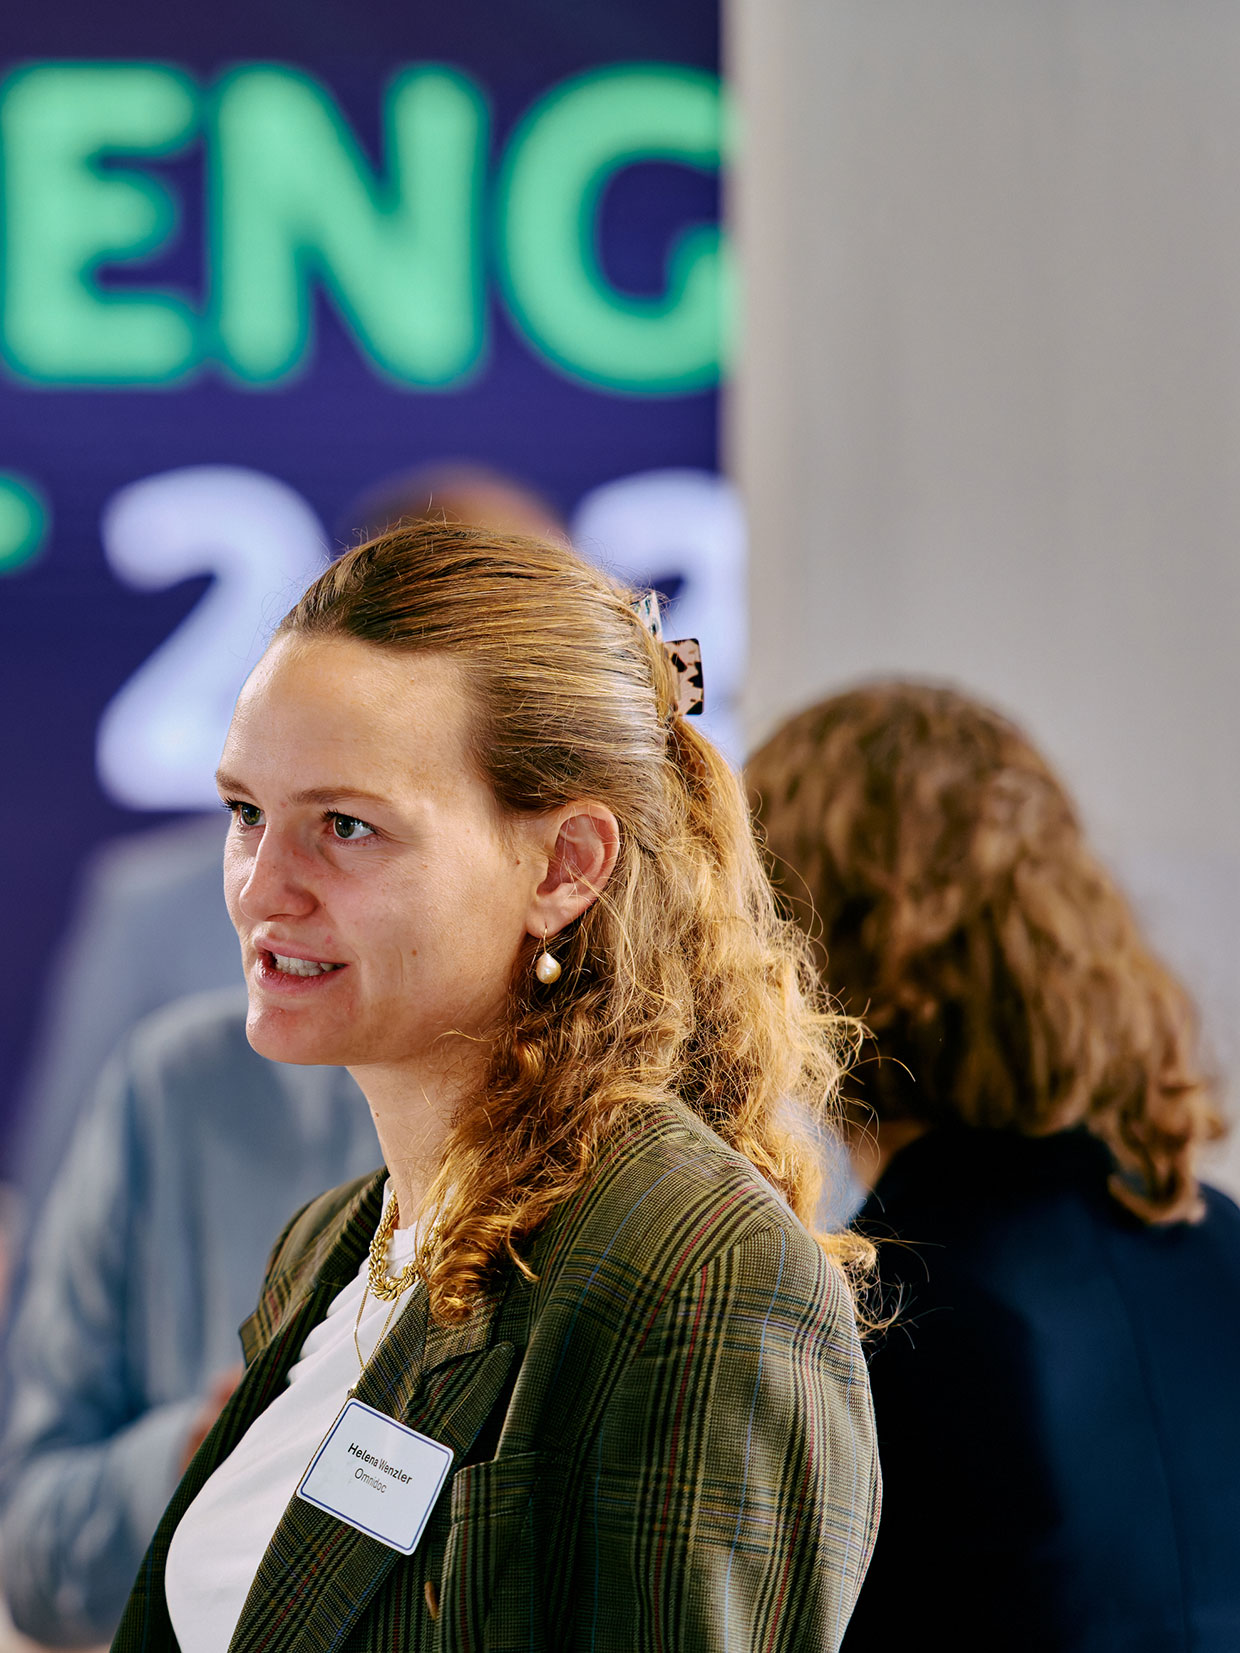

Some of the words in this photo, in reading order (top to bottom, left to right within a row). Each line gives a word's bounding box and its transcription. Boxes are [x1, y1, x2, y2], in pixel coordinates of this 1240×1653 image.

[347, 1442, 379, 1467] Helena
[378, 1458, 413, 1485] Wenzler
[354, 1467, 388, 1493] Omnidoc
